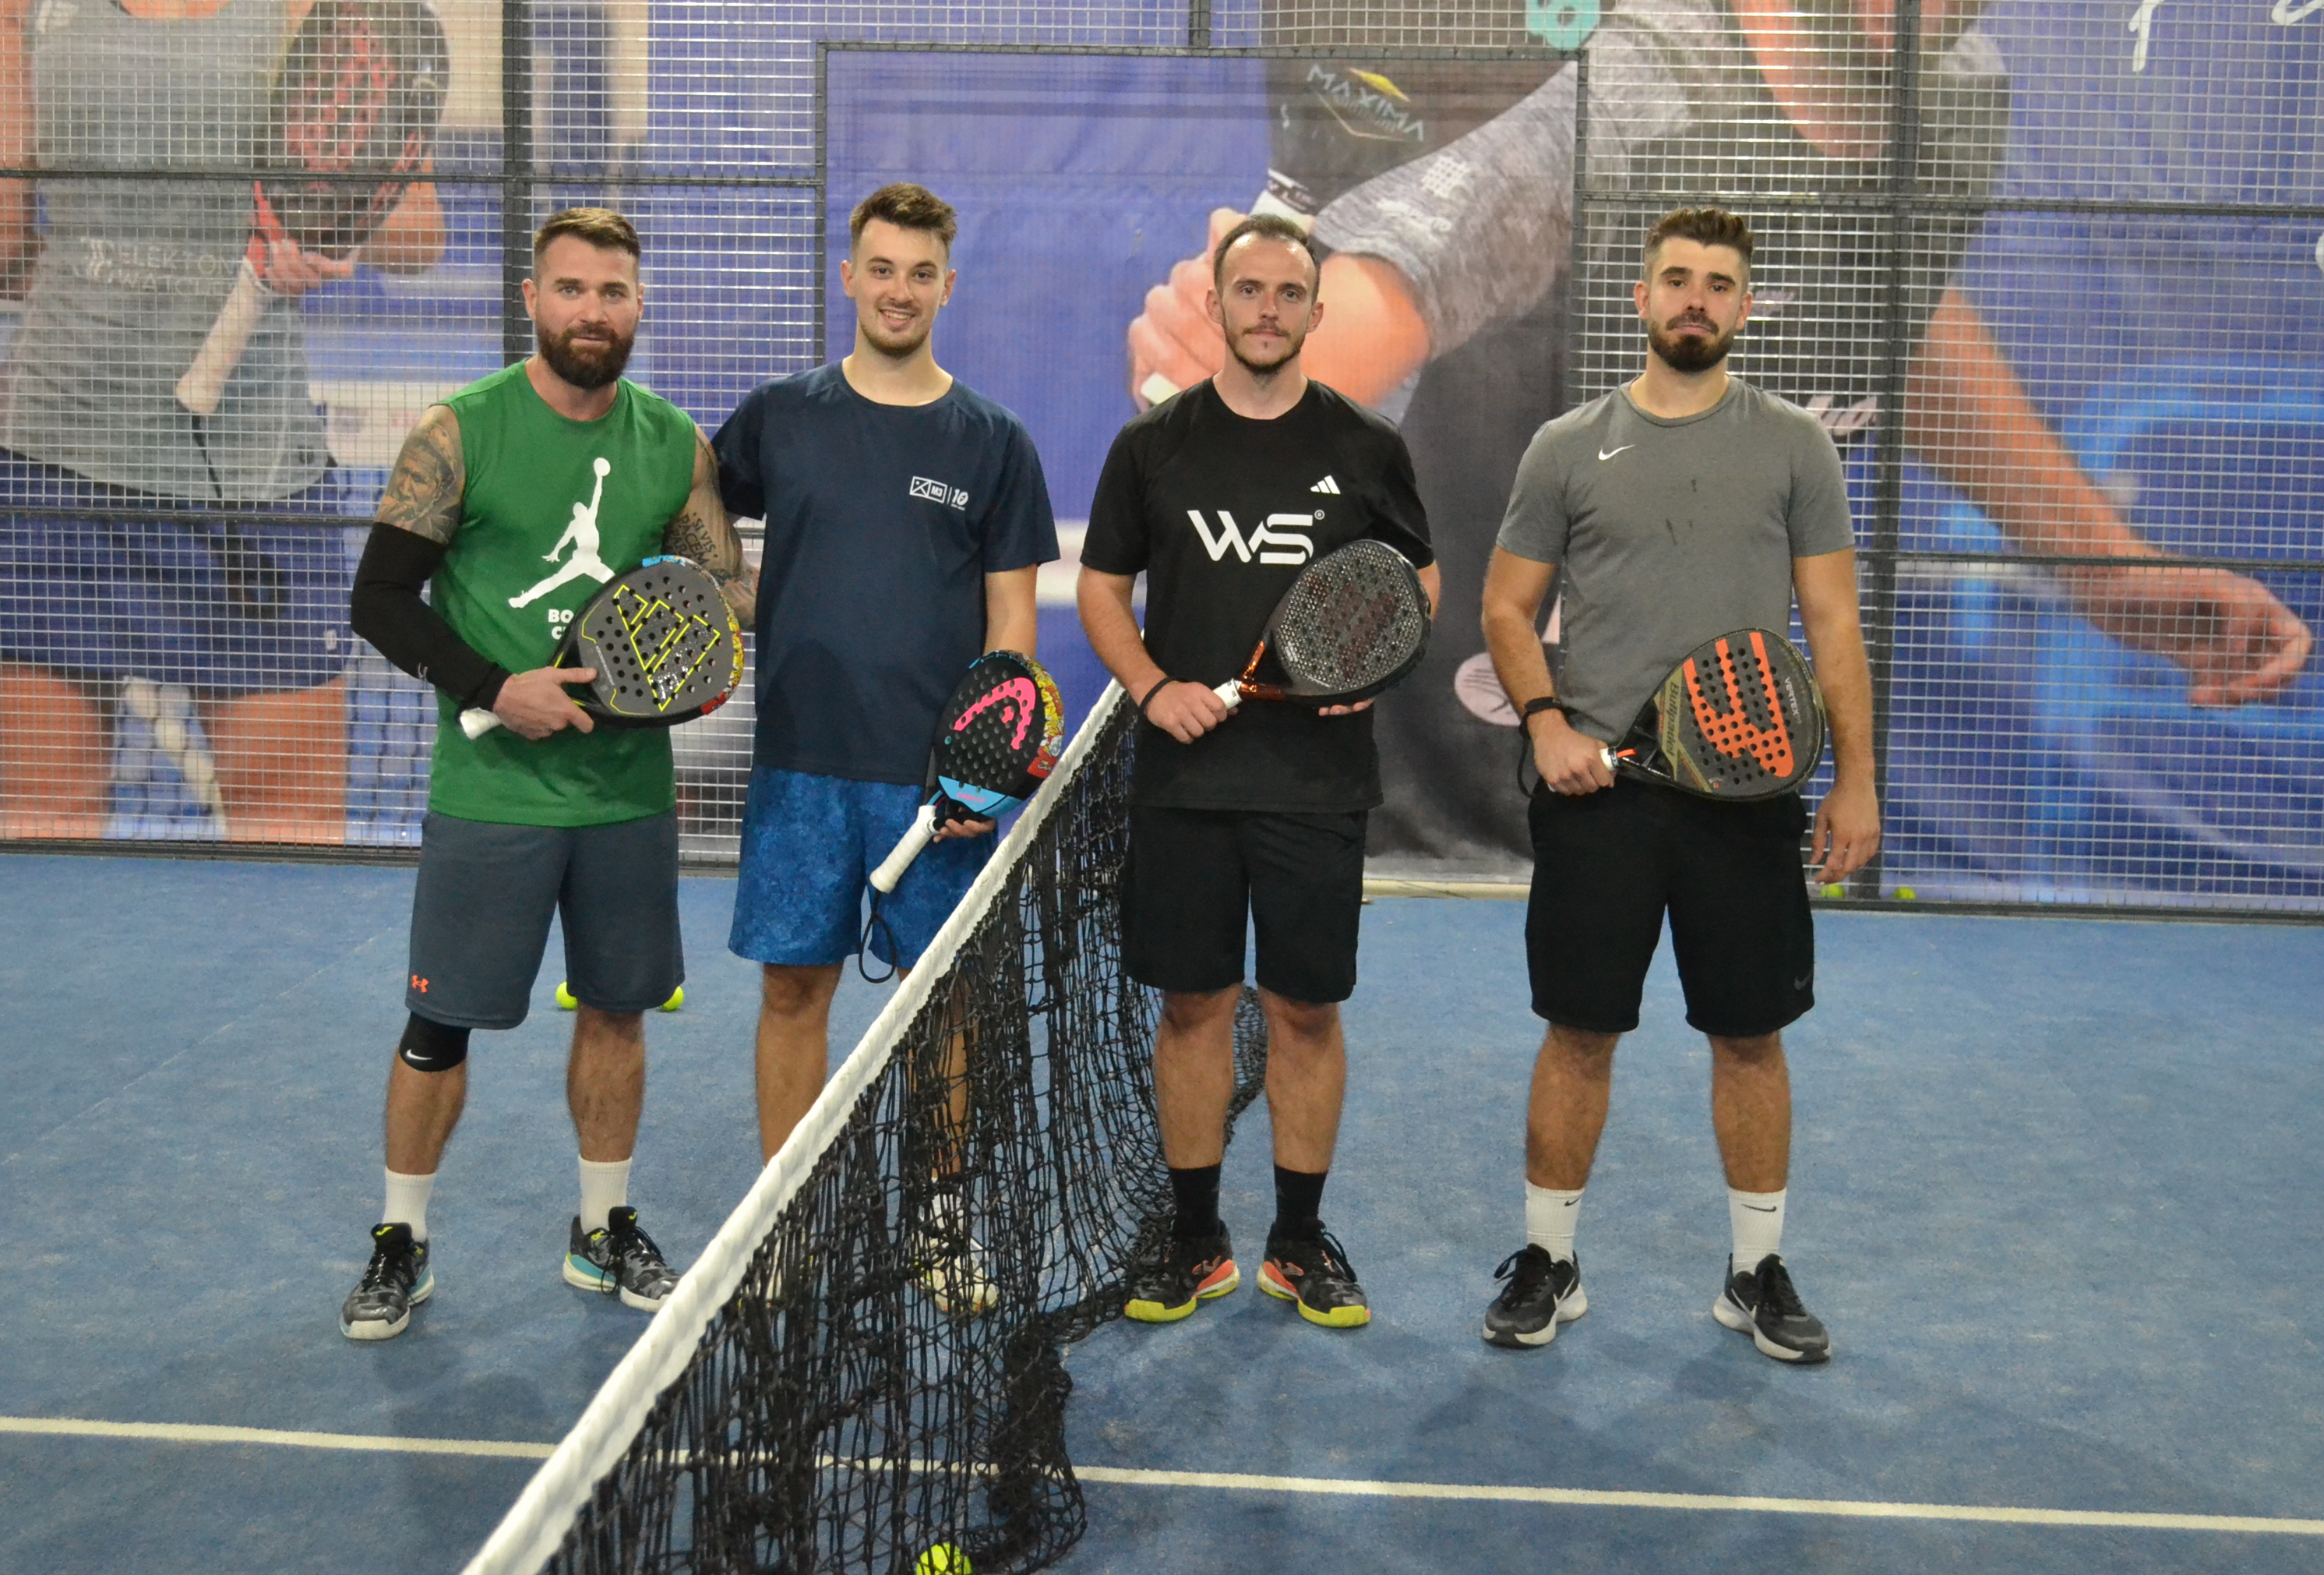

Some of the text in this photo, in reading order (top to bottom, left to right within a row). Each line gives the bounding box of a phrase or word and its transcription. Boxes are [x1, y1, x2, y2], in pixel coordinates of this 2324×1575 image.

[1307, 64, 1424, 141] MAXIMA
[931, 486, 943, 497] M3
[1665, 681, 1680, 756] Bullpadel
